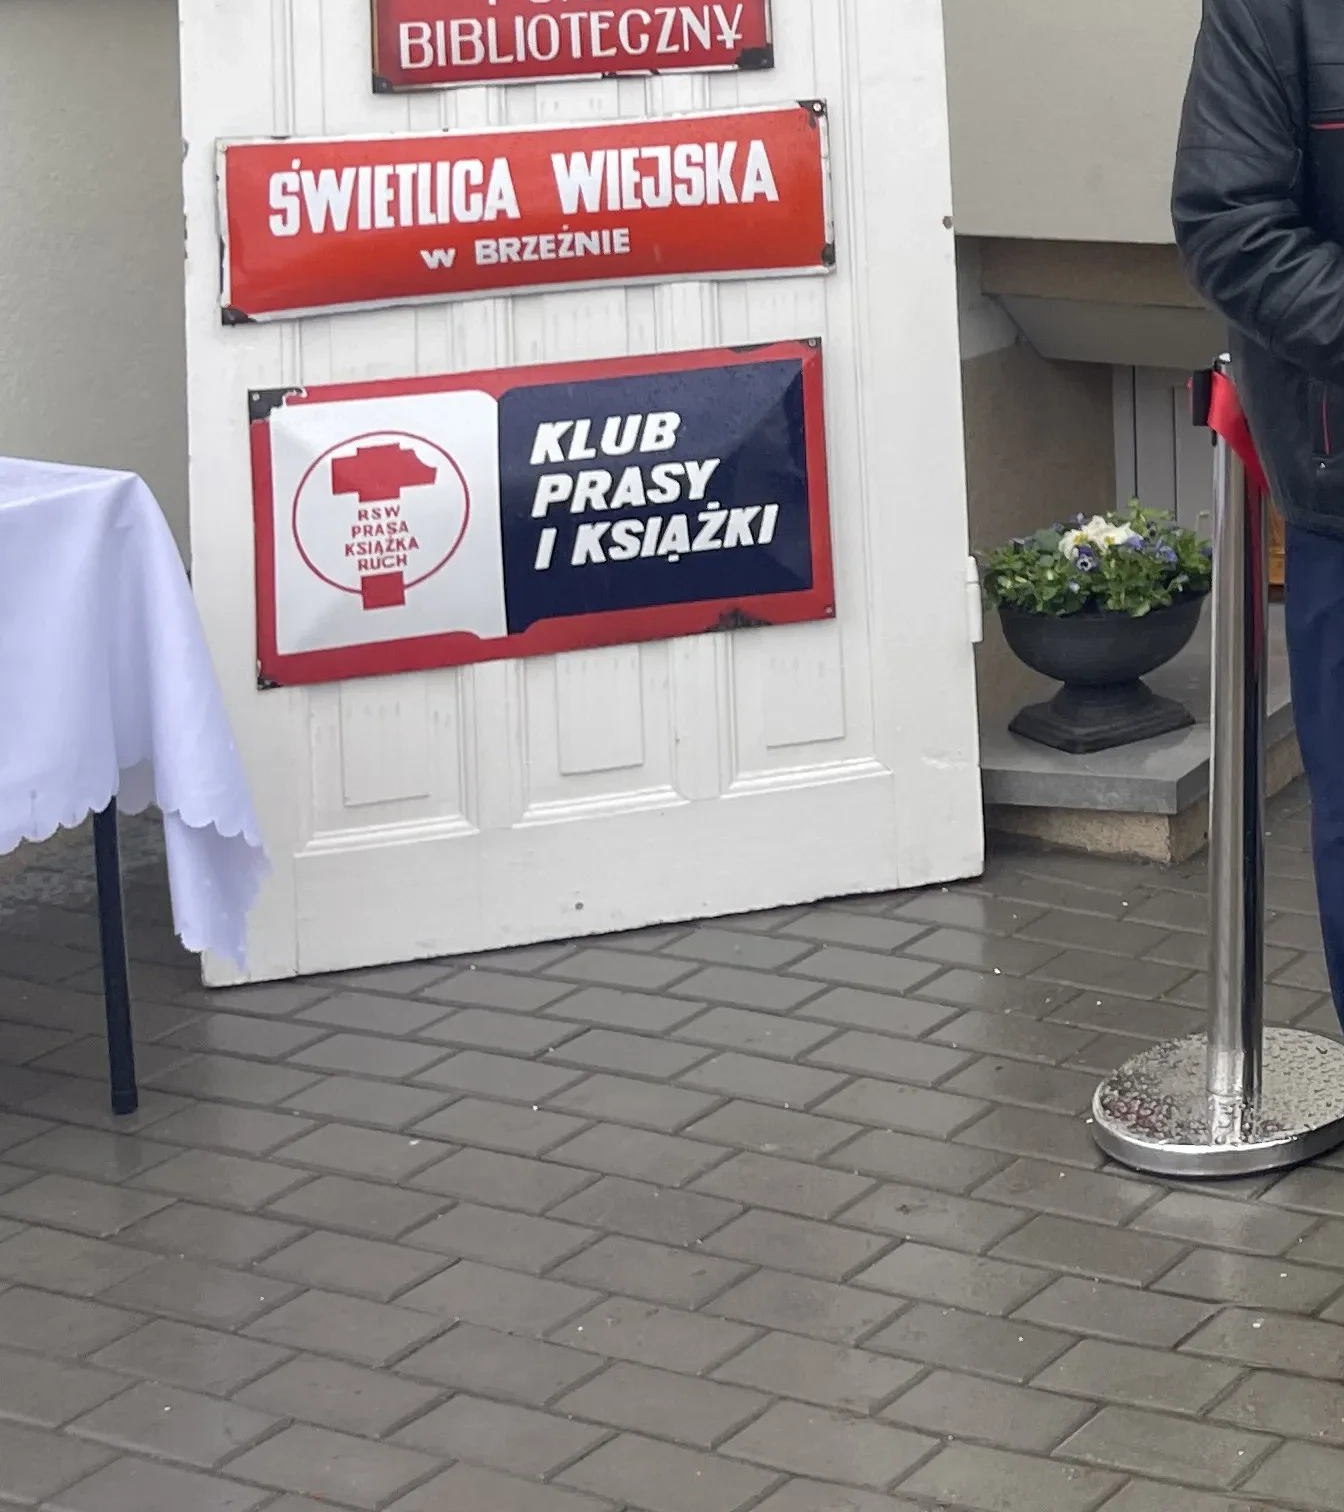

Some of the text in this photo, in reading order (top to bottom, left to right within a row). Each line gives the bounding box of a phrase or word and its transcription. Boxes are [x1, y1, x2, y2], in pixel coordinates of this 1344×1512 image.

[399, 3, 743, 70] BIBLIOTECZNY
[269, 139, 778, 236] ŚWIETLICA WIEJSKA
[529, 411, 681, 465] KLUB
[358, 505, 400, 521] RSW
[531, 458, 721, 519] PRASY
[345, 535, 419, 557] KSIĄŻKA
[351, 520, 409, 538] PRASA
[534, 500, 780, 569] I KSIĄŻKI
[358, 554, 407, 571] RUCH
